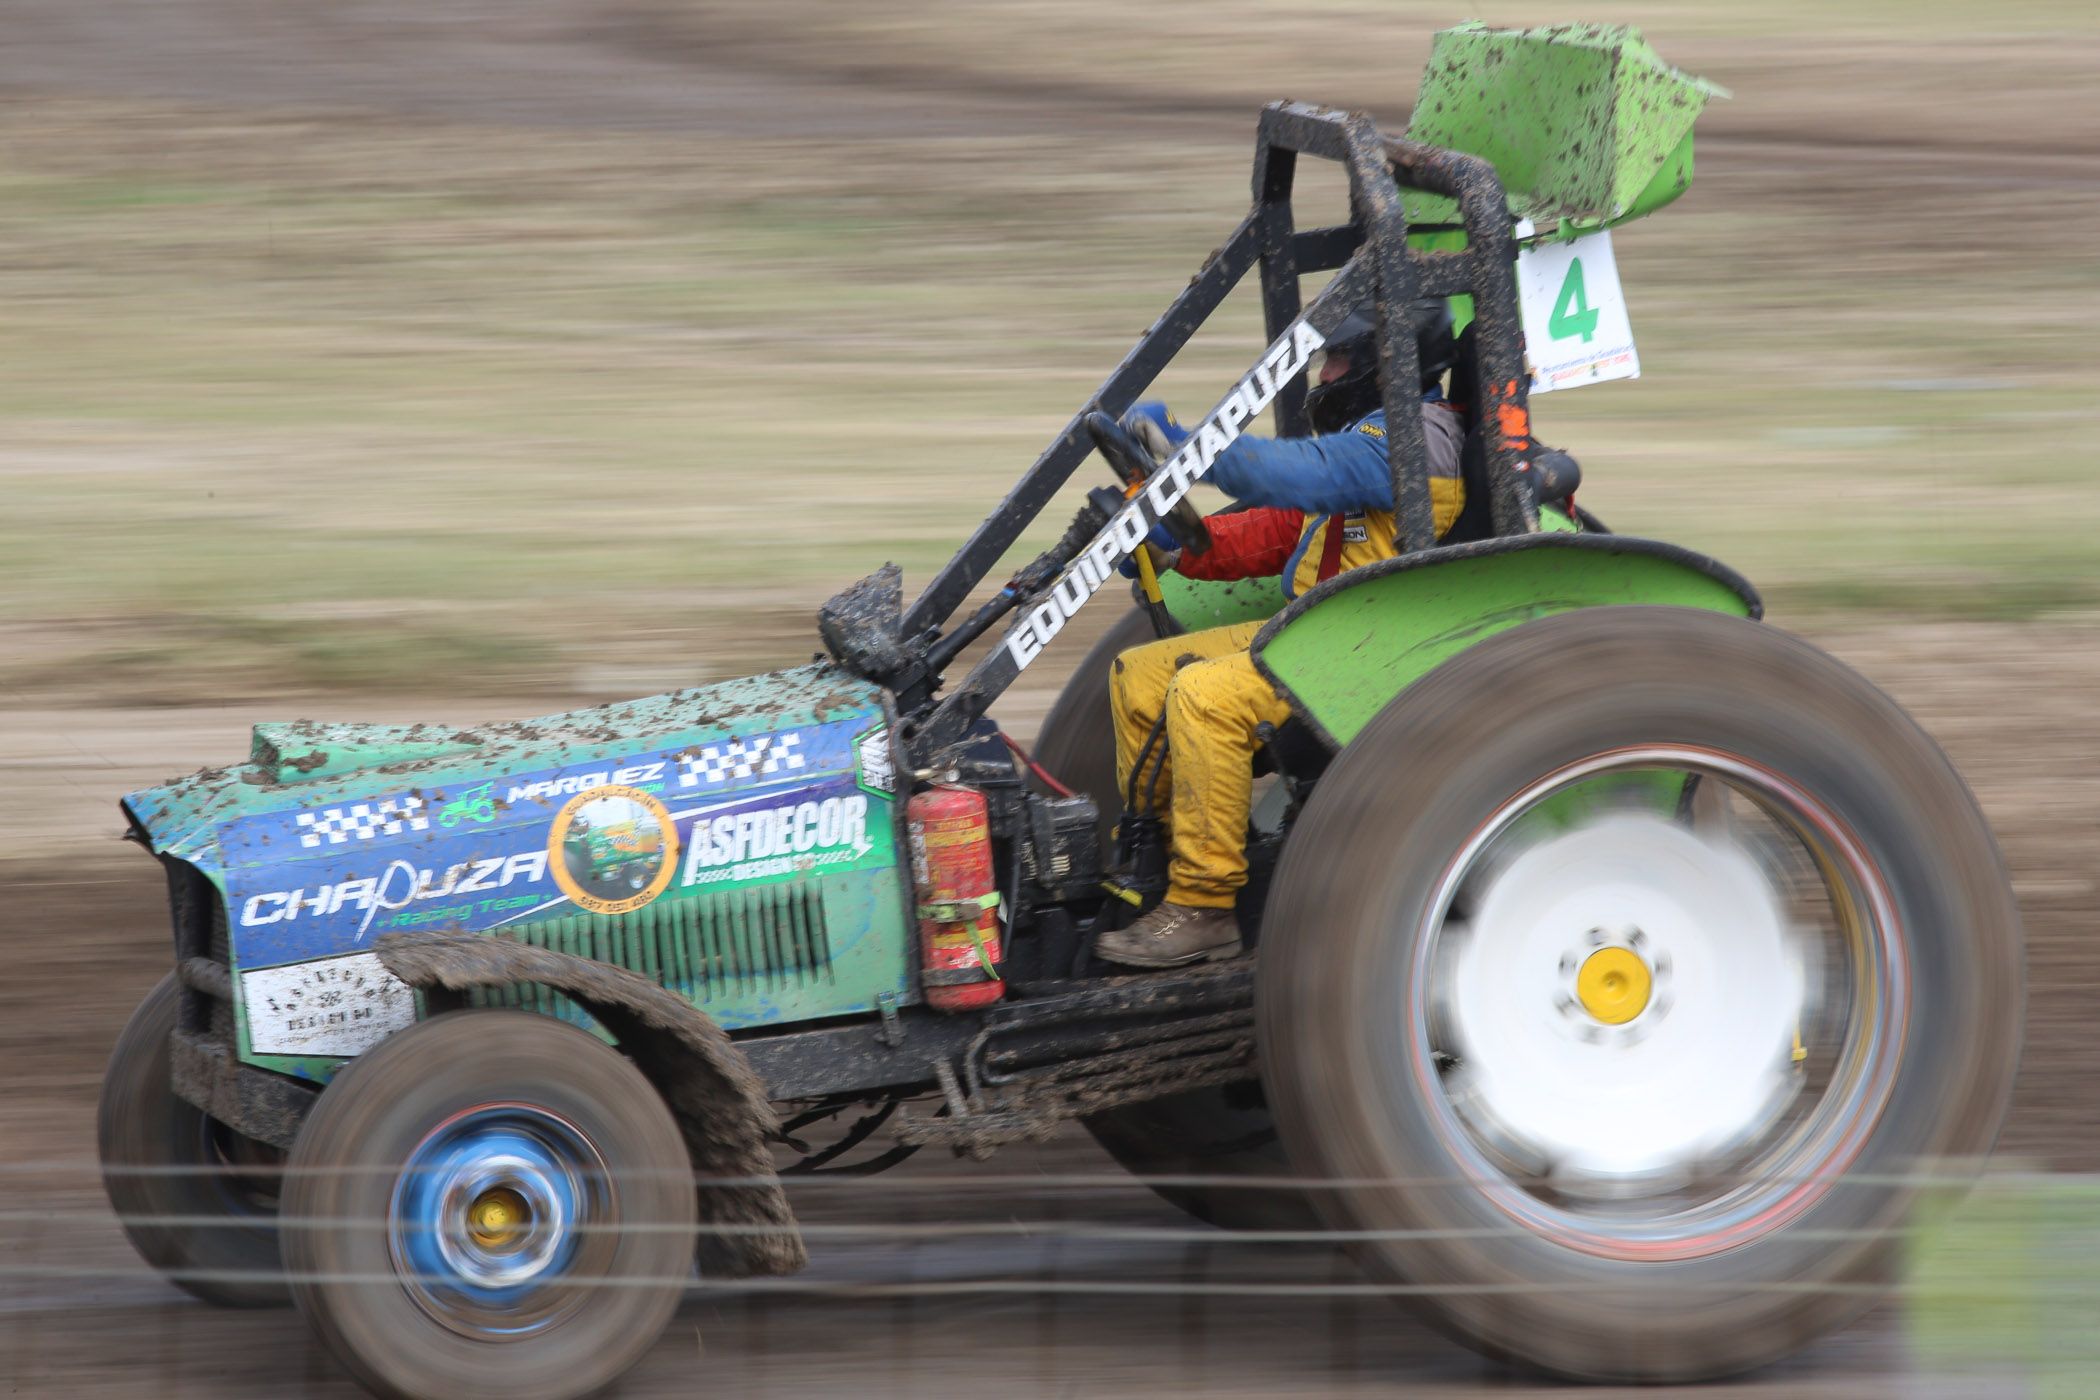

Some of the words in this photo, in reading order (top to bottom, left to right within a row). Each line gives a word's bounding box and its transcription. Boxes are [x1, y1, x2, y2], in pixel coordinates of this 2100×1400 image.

[1548, 256, 1599, 343] 4
[1007, 502, 1149, 671] EQUIPO
[1147, 320, 1326, 517] CHAPUZA
[506, 762, 666, 803] MARQUEZ
[681, 795, 872, 887] ASFDECOR
[391, 902, 473, 927] Racing
[478, 893, 541, 914] Team
